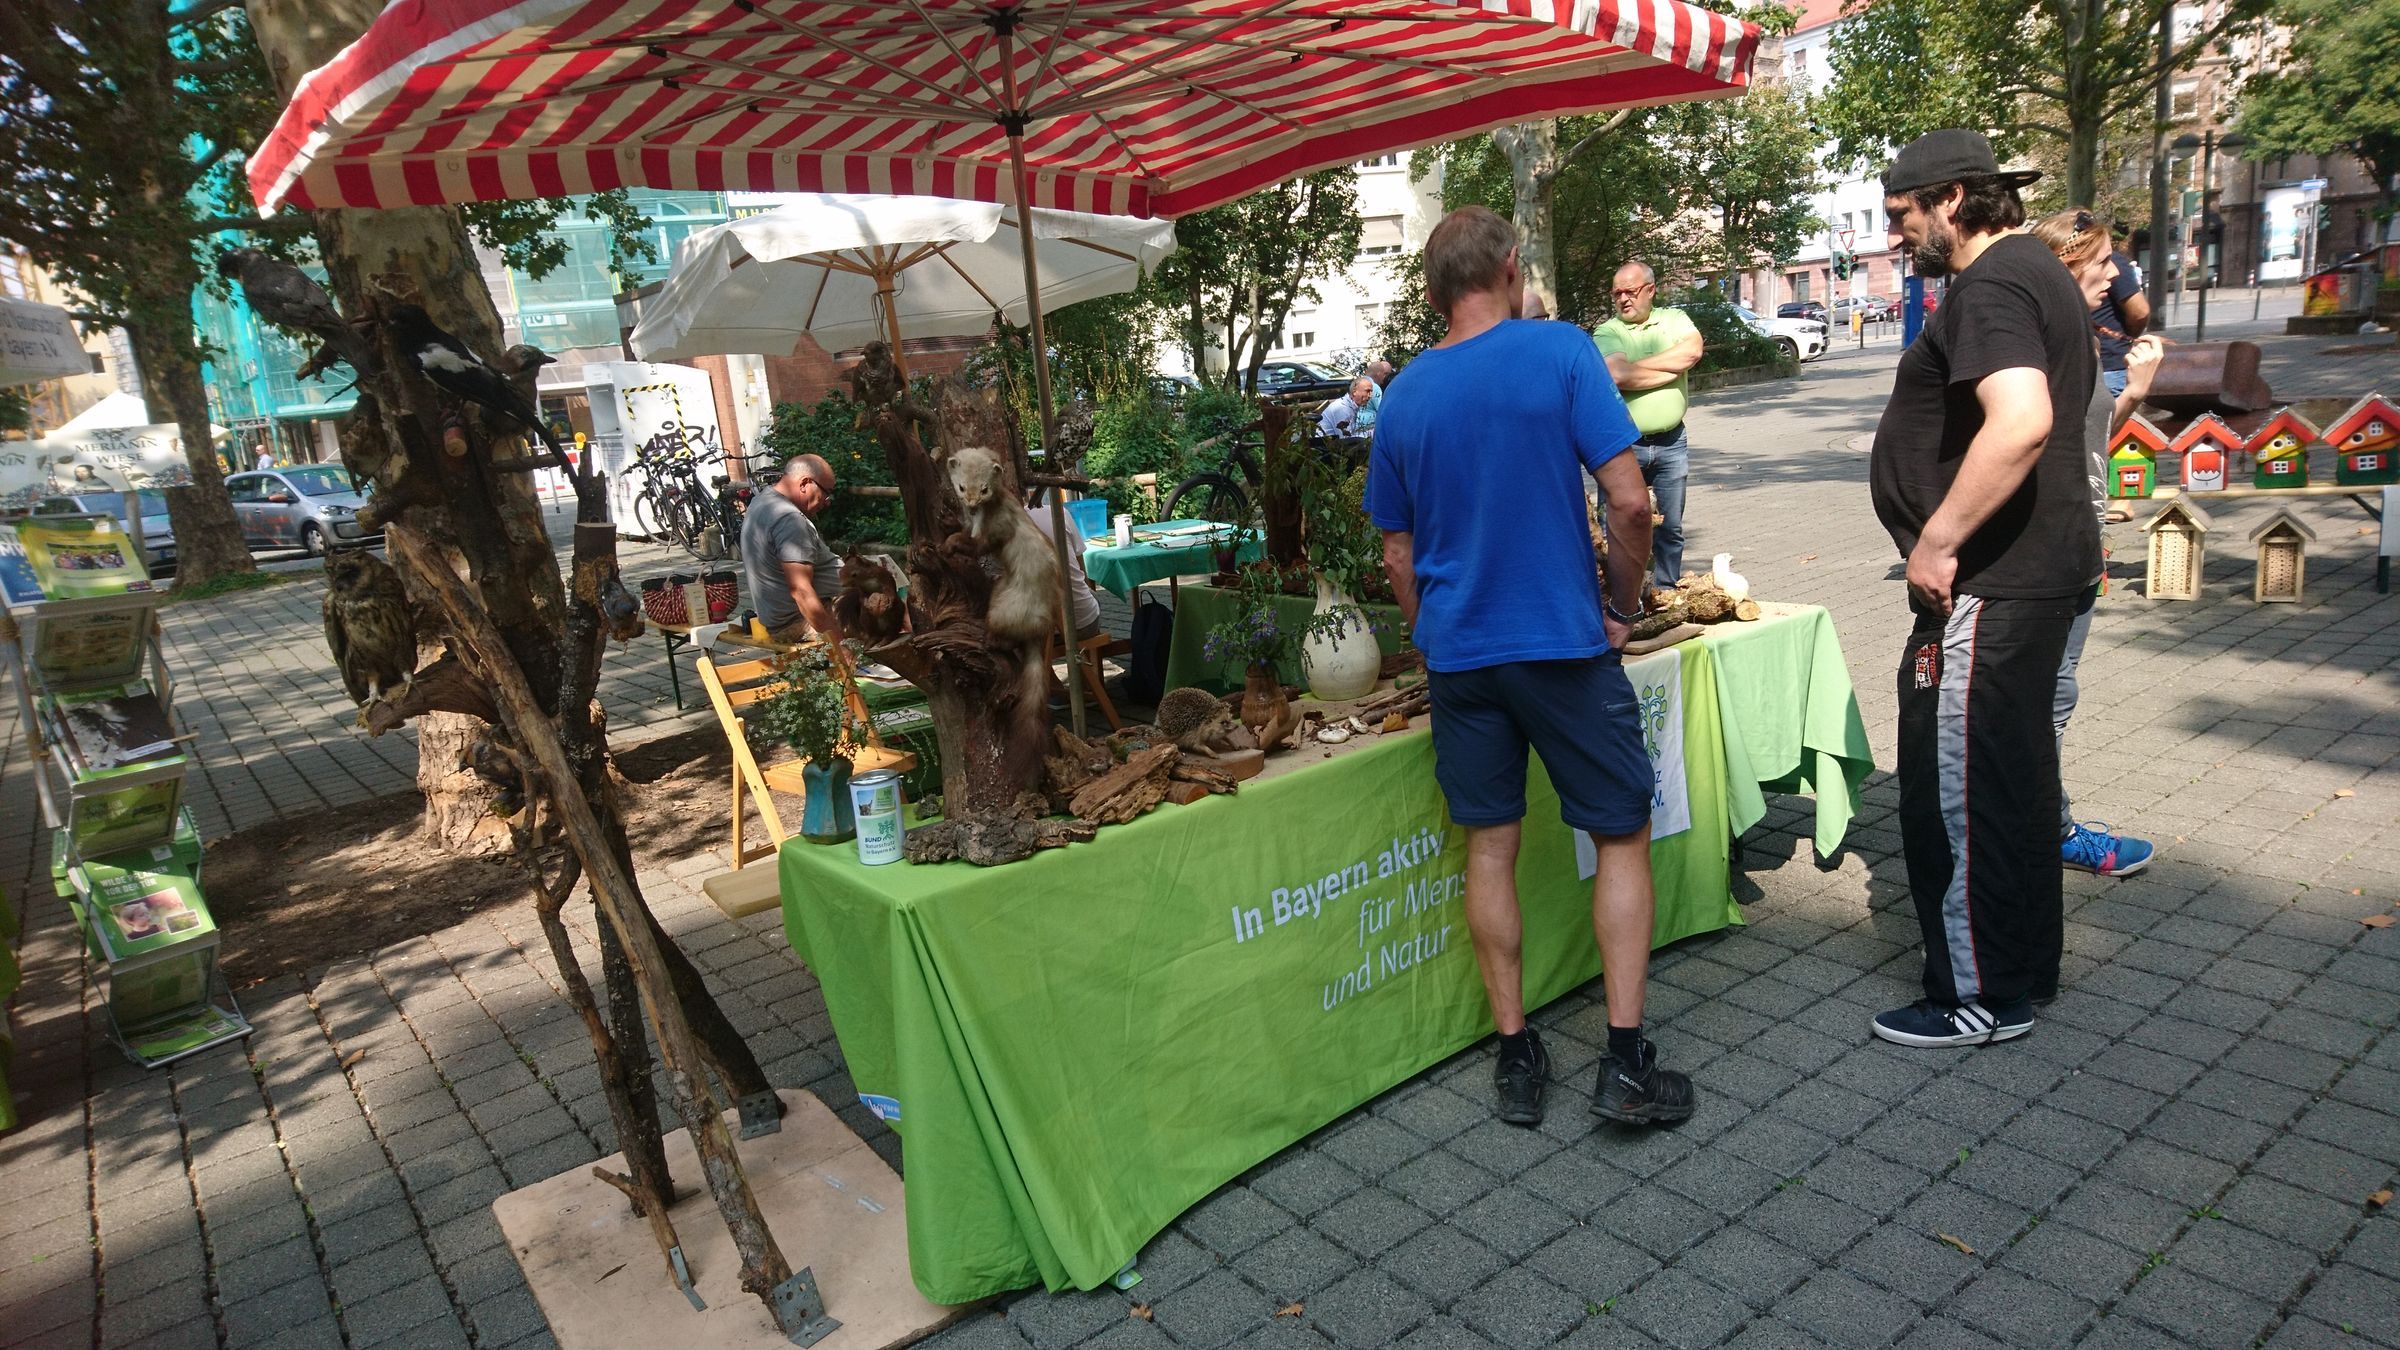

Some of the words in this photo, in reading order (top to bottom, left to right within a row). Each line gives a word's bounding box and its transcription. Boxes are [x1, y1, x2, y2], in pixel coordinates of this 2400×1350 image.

[75, 437, 159, 453] MERIANIN
[96, 451, 145, 464] WIESE
[101, 875, 127, 887] WILDE
[1231, 905, 1264, 944] In
[1271, 860, 1369, 926] Bayern
[1376, 827, 1445, 879] aktiv
[1358, 896, 1396, 949] für
[1323, 951, 1372, 1011] und
[1380, 924, 1451, 980] Natur
